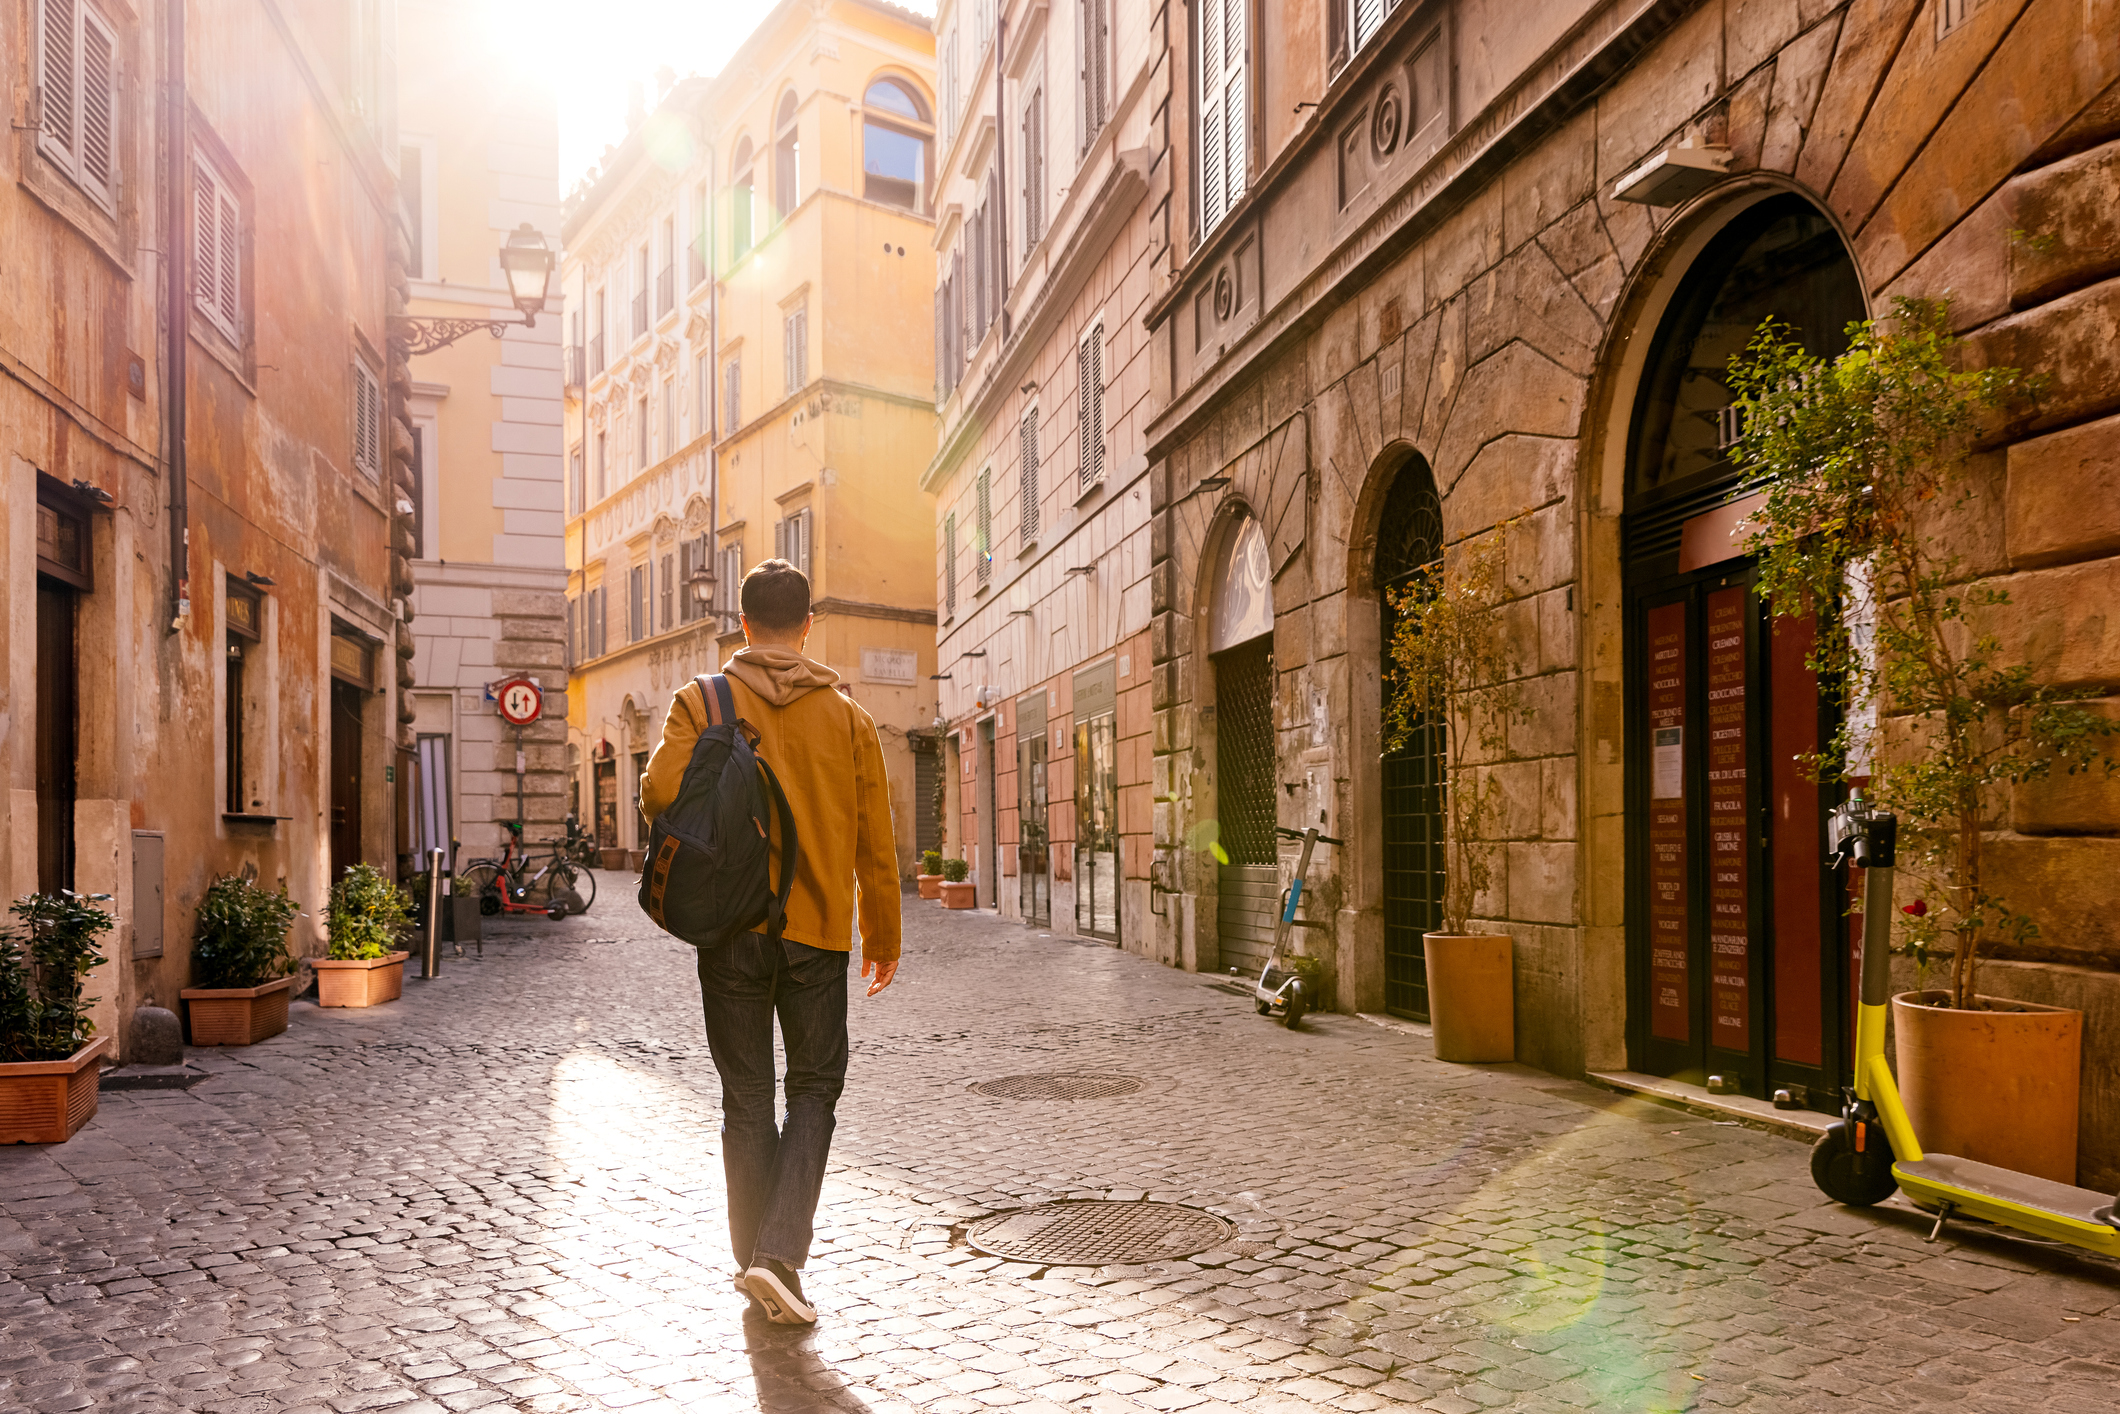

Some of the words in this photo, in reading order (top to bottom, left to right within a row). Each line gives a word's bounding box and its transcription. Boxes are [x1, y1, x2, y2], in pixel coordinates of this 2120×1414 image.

[1715, 606, 1737, 619] CREMA
[1710, 620, 1743, 635] FIORENTINA
[1712, 636, 1741, 650] CREMINO
[1655, 649, 1679, 660] MIRTILLO
[1713, 652, 1741, 665] CREMINO
[1712, 672, 1744, 685] PISTACCHIO
[1653, 679, 1680, 690] NOCCIOLA
[1709, 686, 1745, 700] CROCCANTE
[1652, 708, 1677, 719] PECORINO
[1709, 702, 1745, 716] CROCCANTE
[1659, 718, 1674, 727] MIELE
[1713, 713, 1742, 725] AMARENA
[1713, 728, 1742, 740] DIGESTIVE
[1714, 745, 1732, 755] DULCE
[1734, 744, 1741, 753] DE
[1718, 754, 1736, 764] LECHE
[1729, 769, 1746, 779] LATTE
[1713, 786, 1742, 795] FONDENTE
[1714, 801, 1742, 811] FRAGOLA
[1657, 815, 1679, 824] SESAMO
[1734, 833, 1741, 841] AL
[1655, 844, 1676, 853] TARTUFO
[1717, 842, 1740, 851] LIMONE
[1715, 858, 1742, 867] LAMPONE
[1718, 873, 1740, 882] LIMONE
[1657, 882, 1673, 891] TORTA
[1675, 883, 1680, 891] DI
[1661, 892, 1675, 900] MELE
[1716, 904, 1742, 914] MALAGA
[1658, 921, 1680, 930] YOGURT
[1712, 920, 1746, 930] MANDORLA
[1712, 935, 1748, 946] MANDARINO
[1654, 949, 1686, 960] ZAFFERANO
[1718, 945, 1746, 956] ZENZERO
[1658, 959, 1687, 969] PISTACCHIO
[1718, 961, 1742, 971] MANGO
[1661, 988, 1678, 998] ZUPPA
[1660, 996, 1680, 1008] INGLESE
[1718, 1016, 1743, 1028] MELONE
